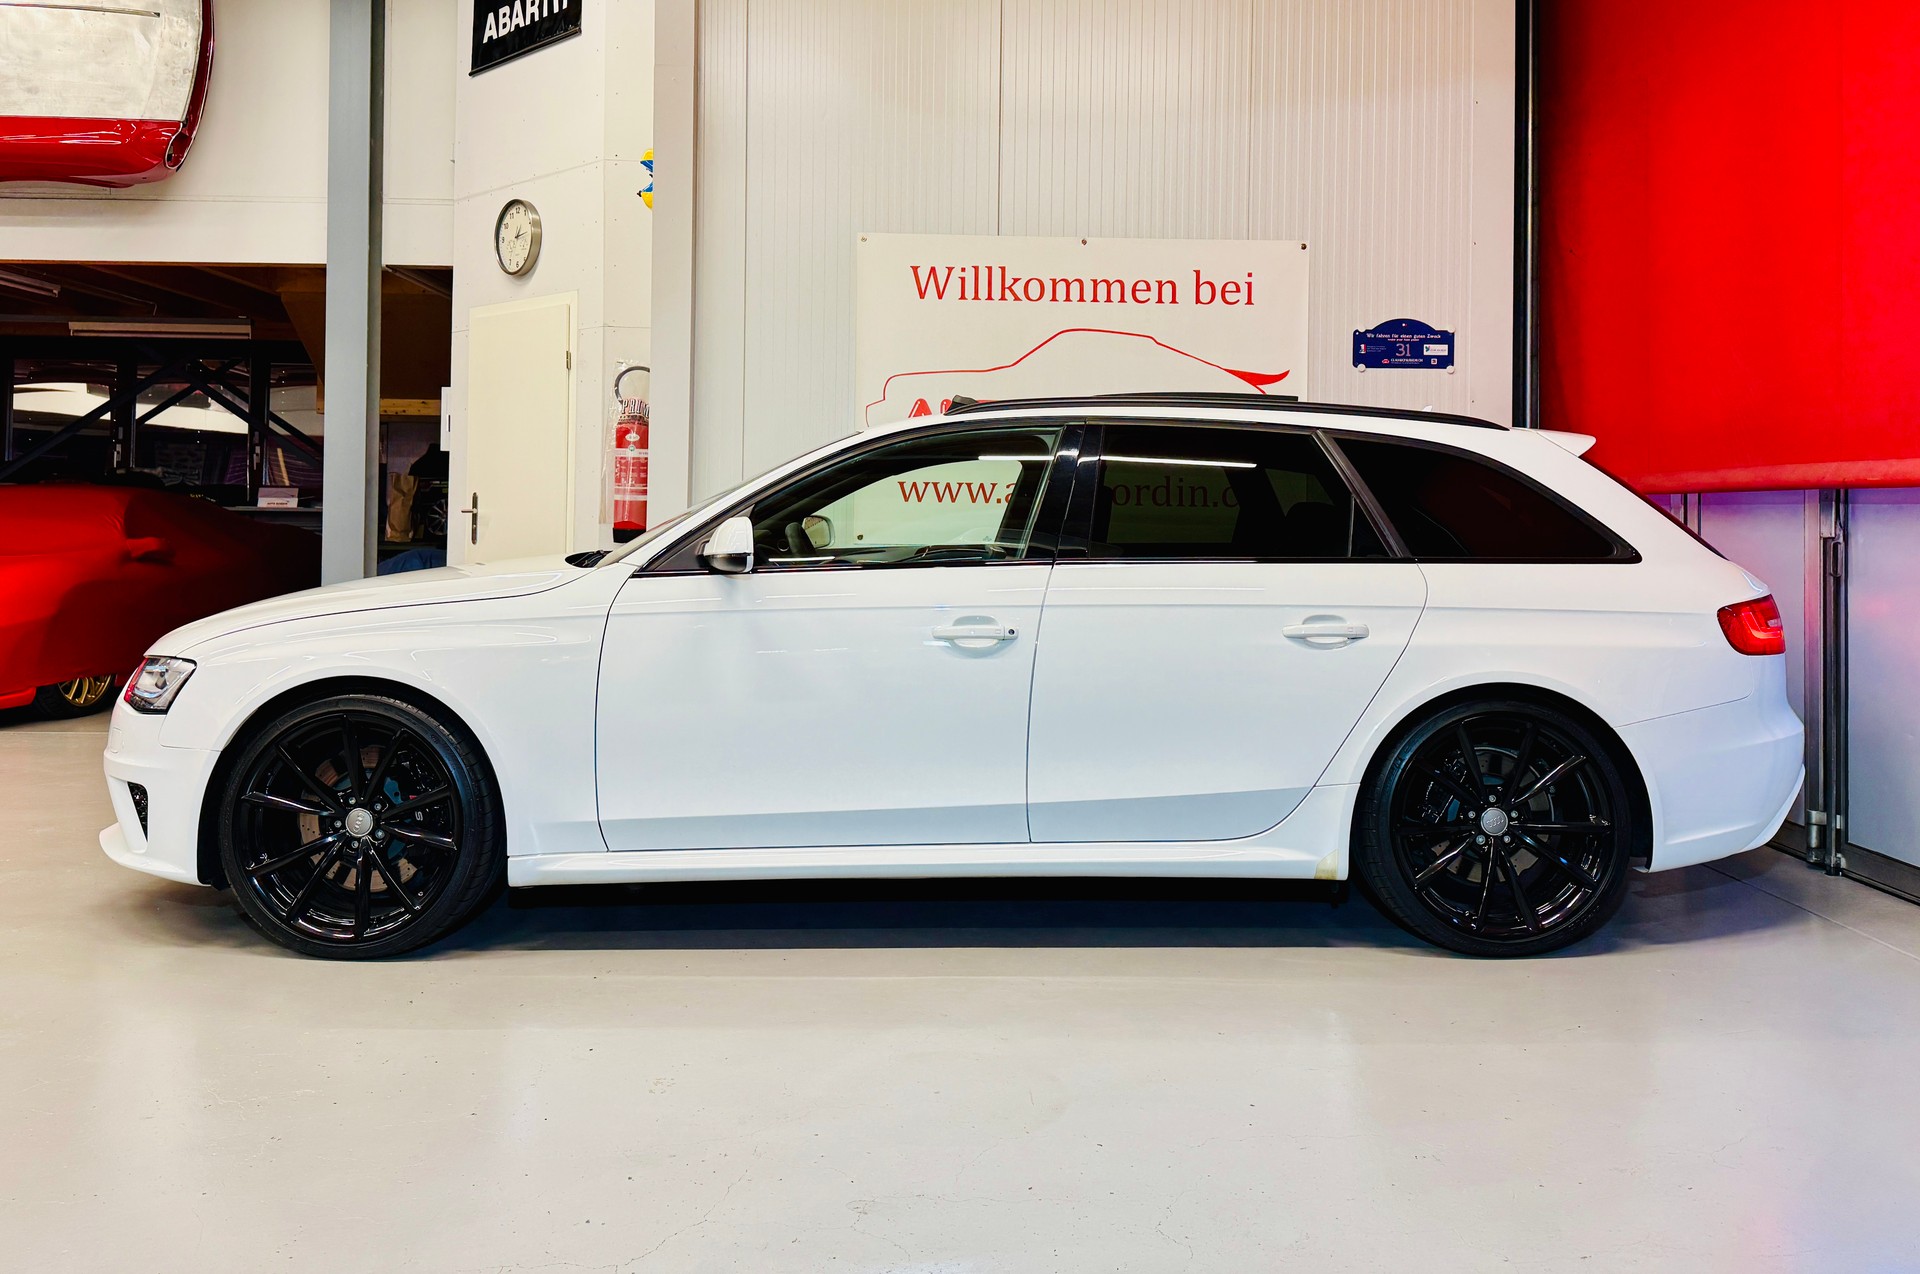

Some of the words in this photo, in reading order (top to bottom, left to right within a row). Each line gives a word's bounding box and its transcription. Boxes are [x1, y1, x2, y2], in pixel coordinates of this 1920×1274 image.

[911, 265, 1179, 305] Willkommen
[1193, 269, 1254, 306] bei
[1395, 343, 1411, 357] 31
